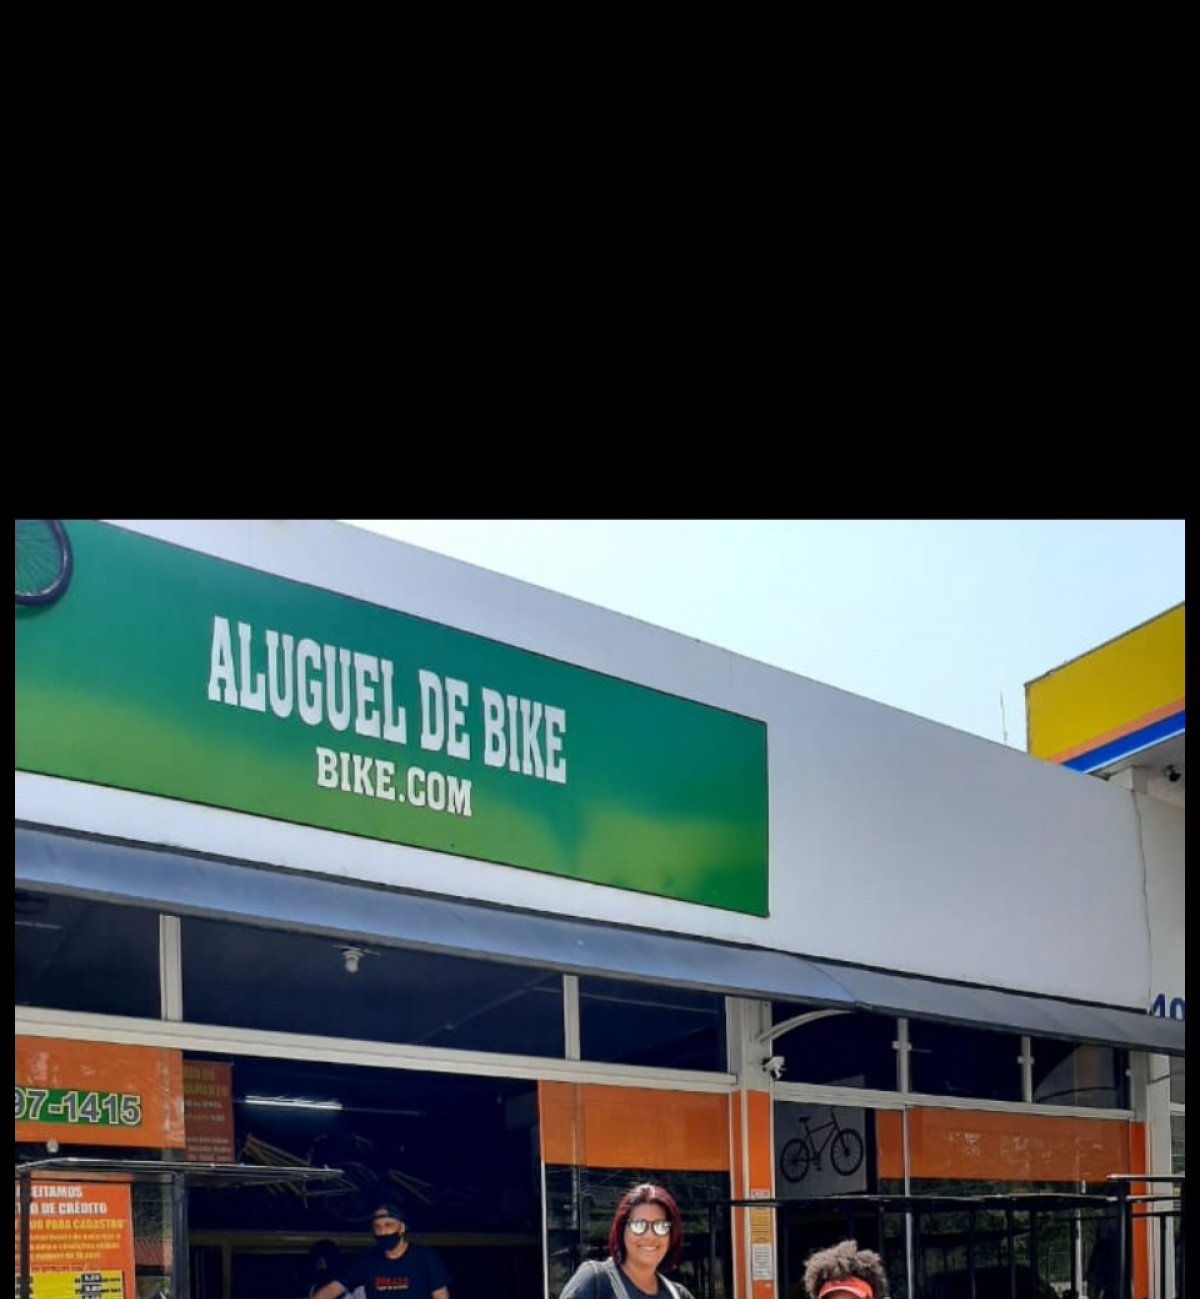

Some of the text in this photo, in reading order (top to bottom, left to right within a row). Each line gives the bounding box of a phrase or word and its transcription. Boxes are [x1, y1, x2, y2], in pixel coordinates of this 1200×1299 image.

[207, 615, 567, 784] ALUGUEL DE BIKE
[315, 746, 473, 817] BIKE.COM
[41, 1202, 55, 1215] DE
[58, 1200, 107, 1215] CRÉDITO
